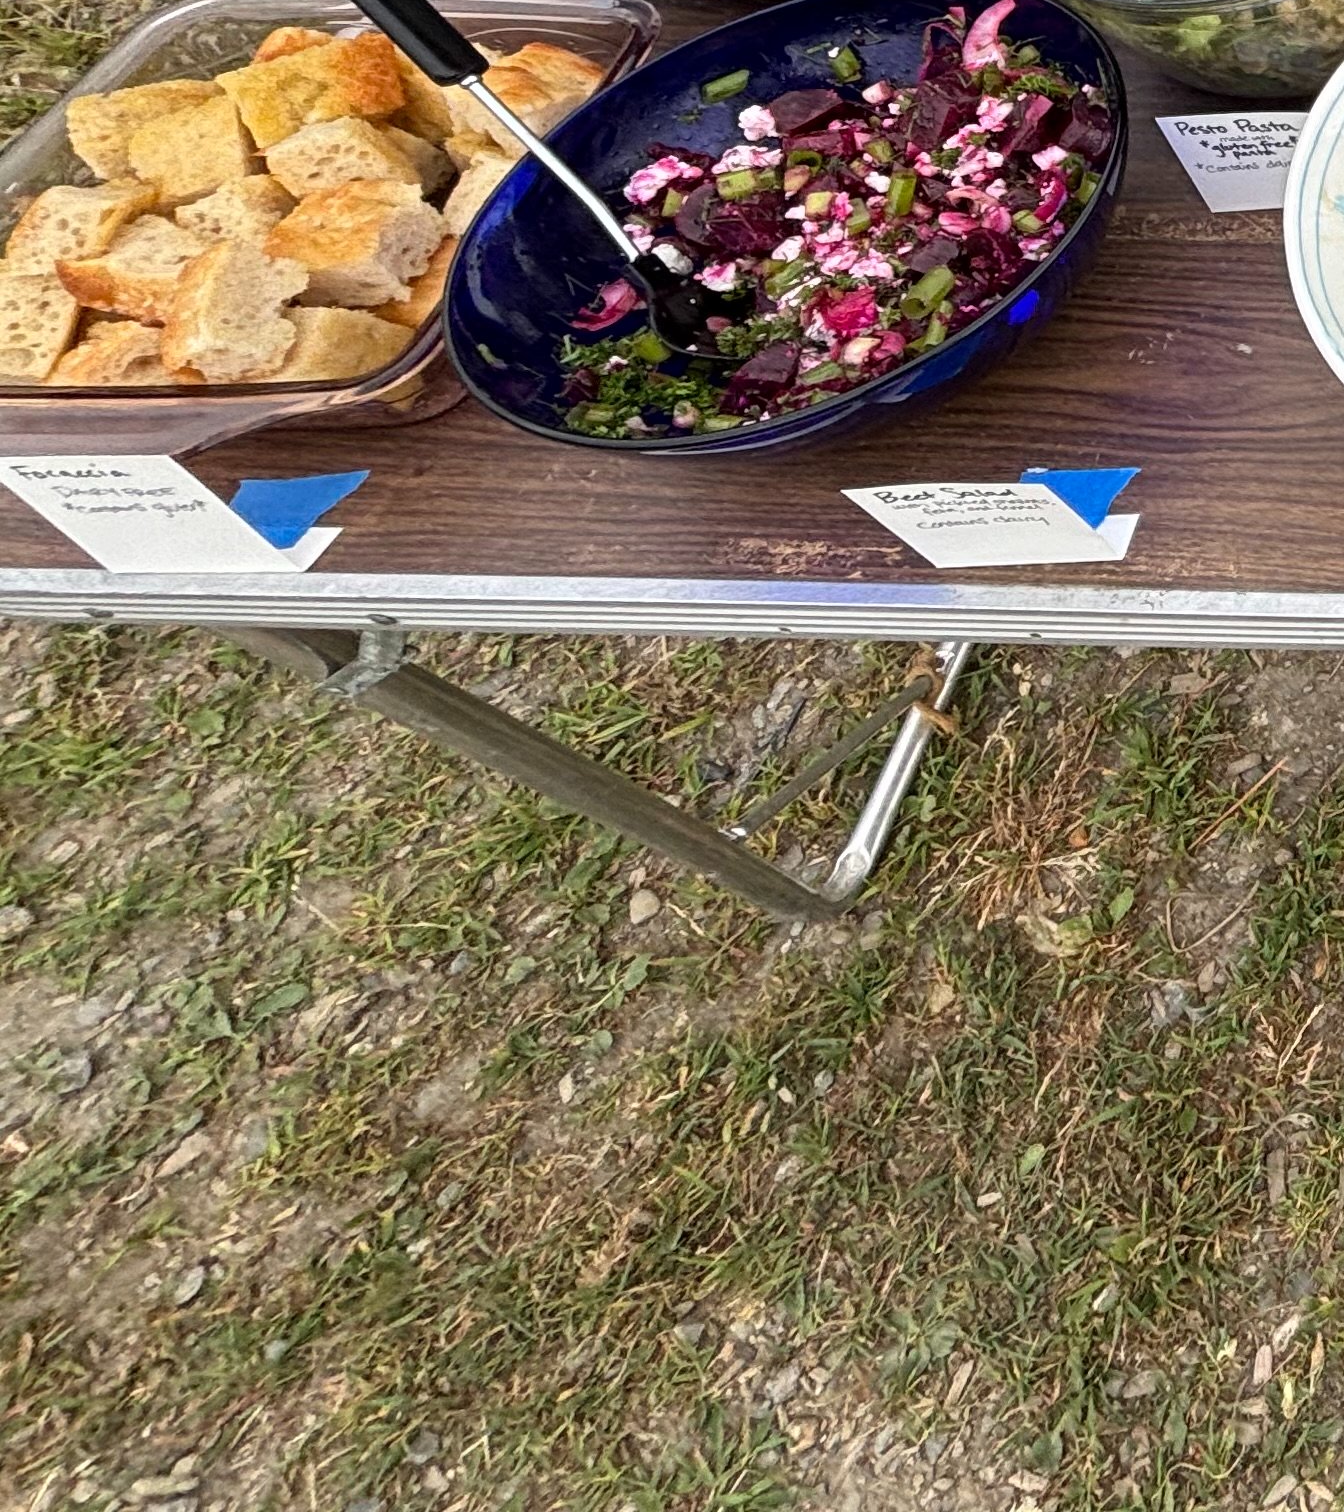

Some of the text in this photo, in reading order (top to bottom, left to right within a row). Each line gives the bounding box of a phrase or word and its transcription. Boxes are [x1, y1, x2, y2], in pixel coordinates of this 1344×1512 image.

[1174, 118, 1299, 136] Pesto Pasta
[1266, 159, 1292, 169] dair
[873, 487, 1018, 504] Beet Salad
